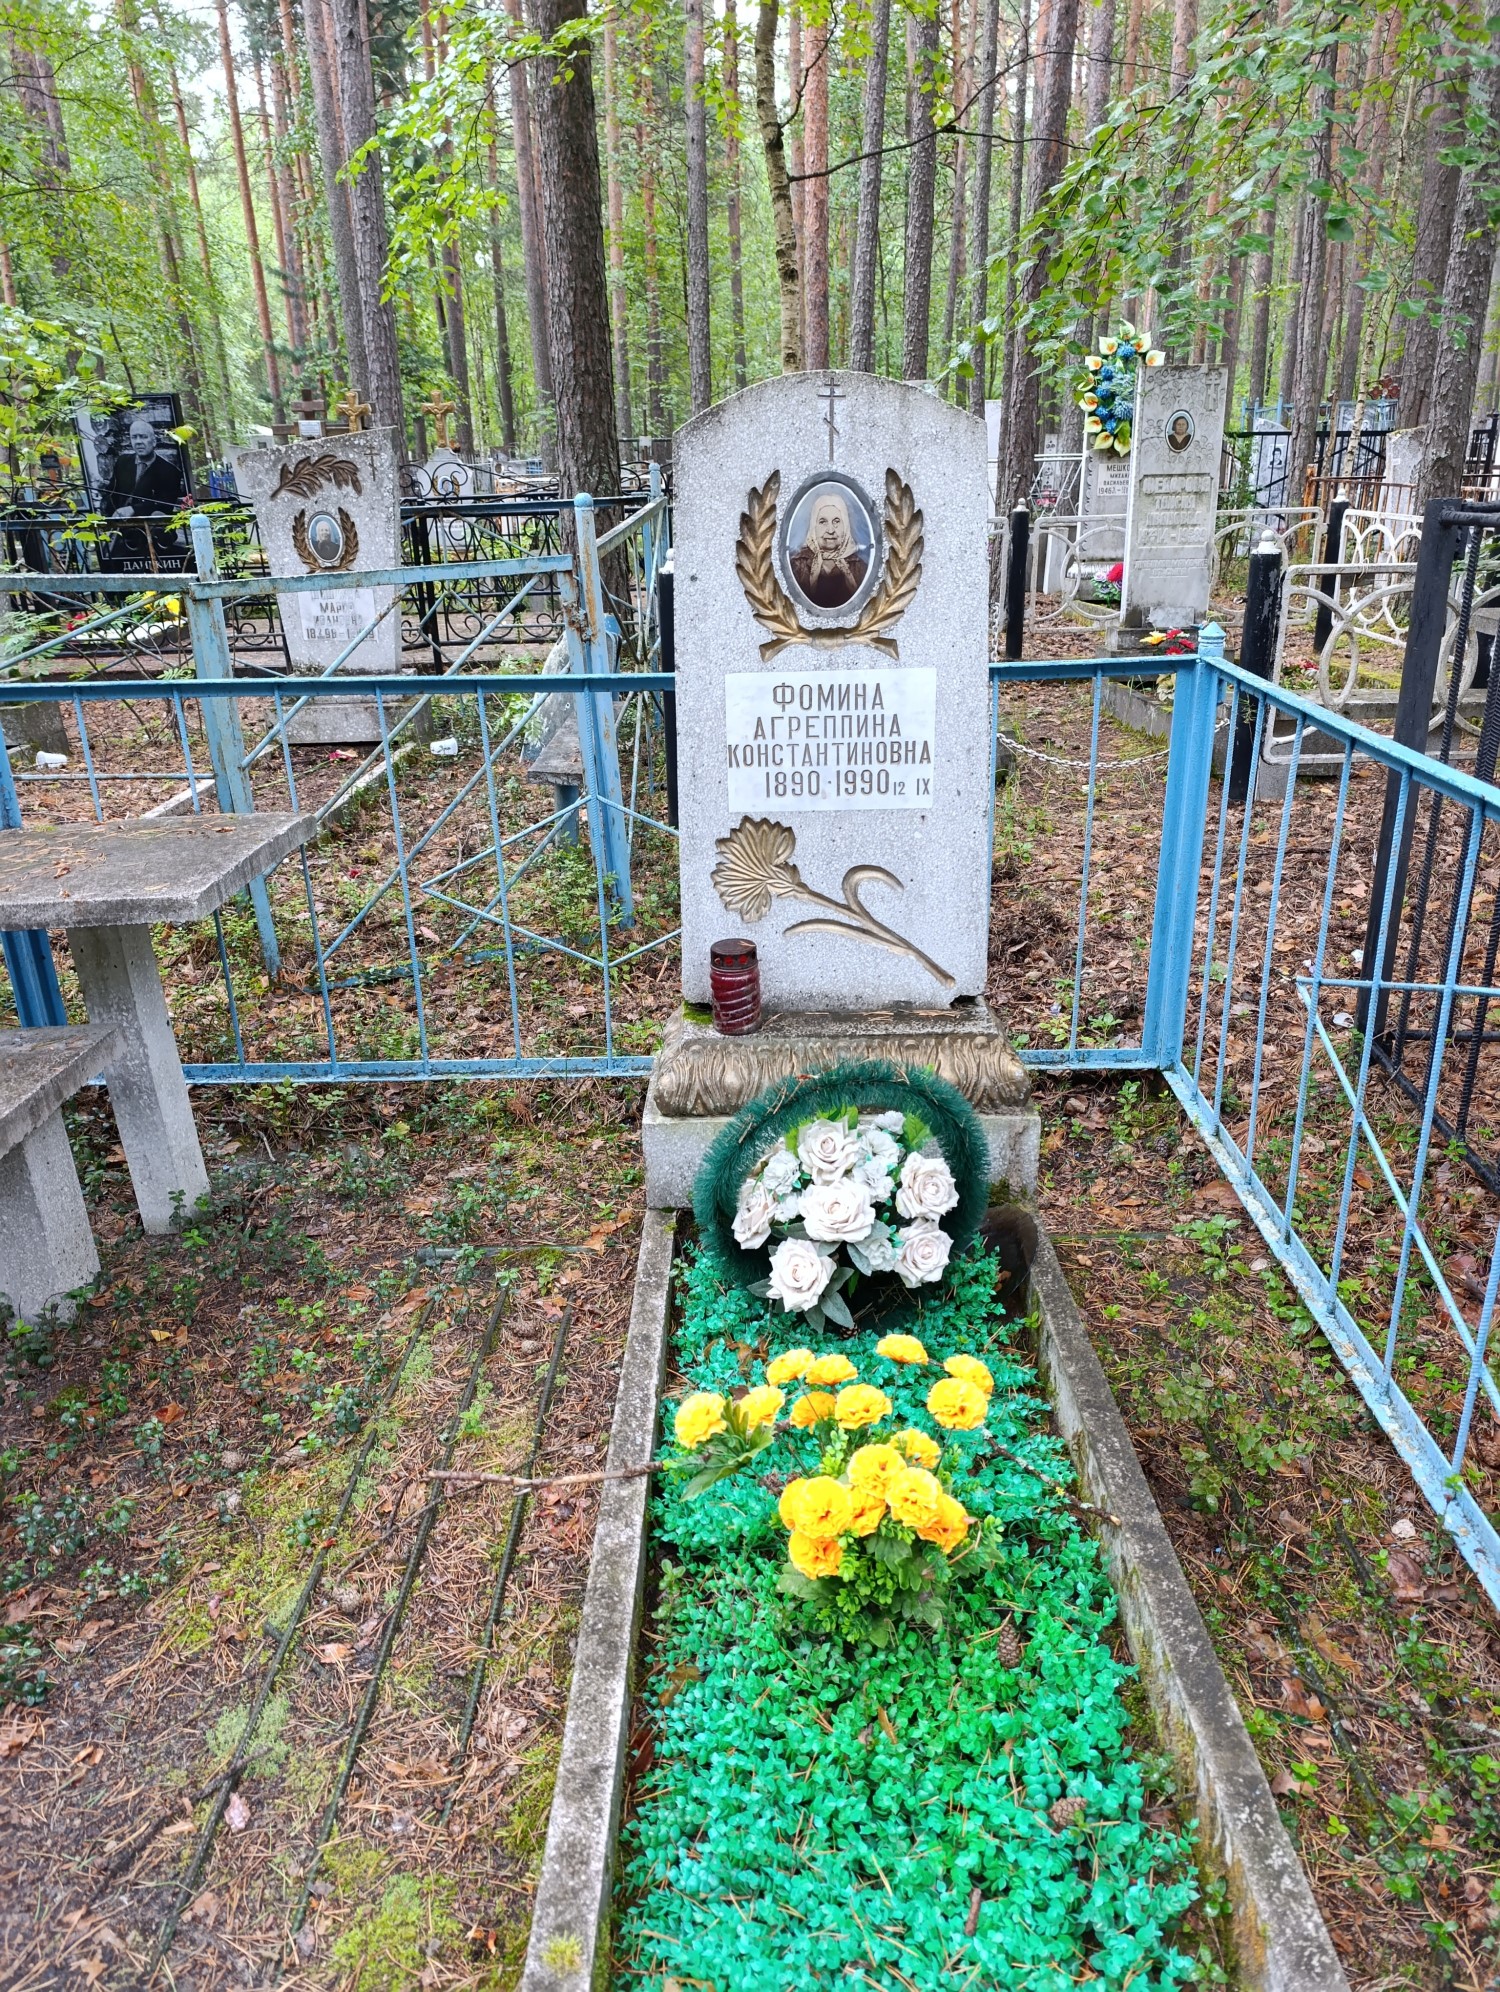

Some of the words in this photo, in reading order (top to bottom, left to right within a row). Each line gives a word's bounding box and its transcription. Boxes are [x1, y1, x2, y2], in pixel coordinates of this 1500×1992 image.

[772, 682, 885, 713] ФОМИНА
[753, 713, 902, 741] АГРЕППИНА
[727, 740, 932, 769] КОНСТАНТИНОВНА
